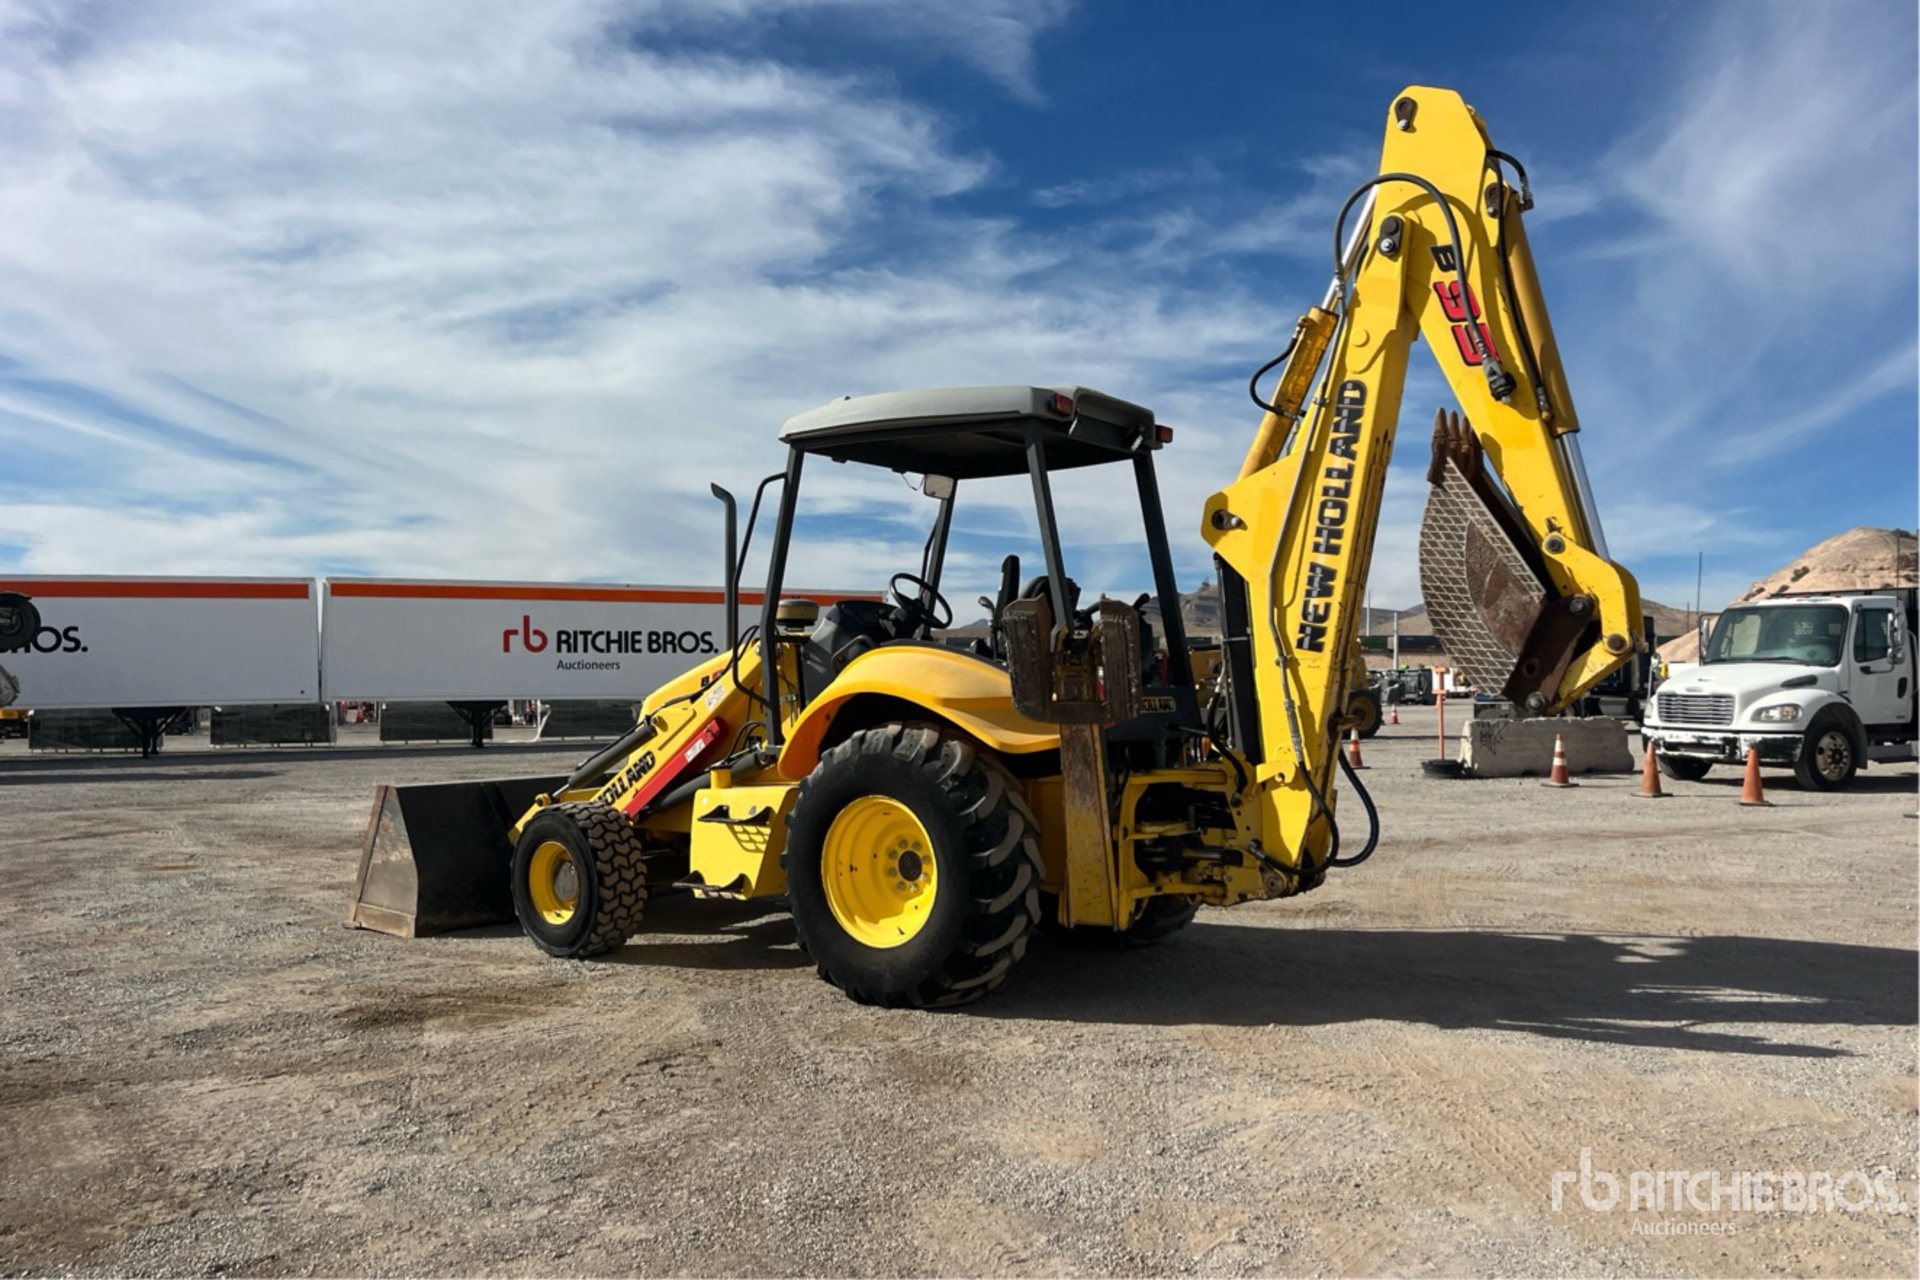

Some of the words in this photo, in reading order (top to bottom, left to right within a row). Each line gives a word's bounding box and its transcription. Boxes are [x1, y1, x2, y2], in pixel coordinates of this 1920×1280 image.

[1312, 379, 1368, 556] HOLLAND
[1296, 561, 1337, 653] NEW
[0, 626, 88, 653] OS.
[502, 615, 549, 653] rb
[556, 630, 643, 653] RITCHIE
[648, 630, 719, 654] BROS.
[556, 659, 621, 670] Auctioneers
